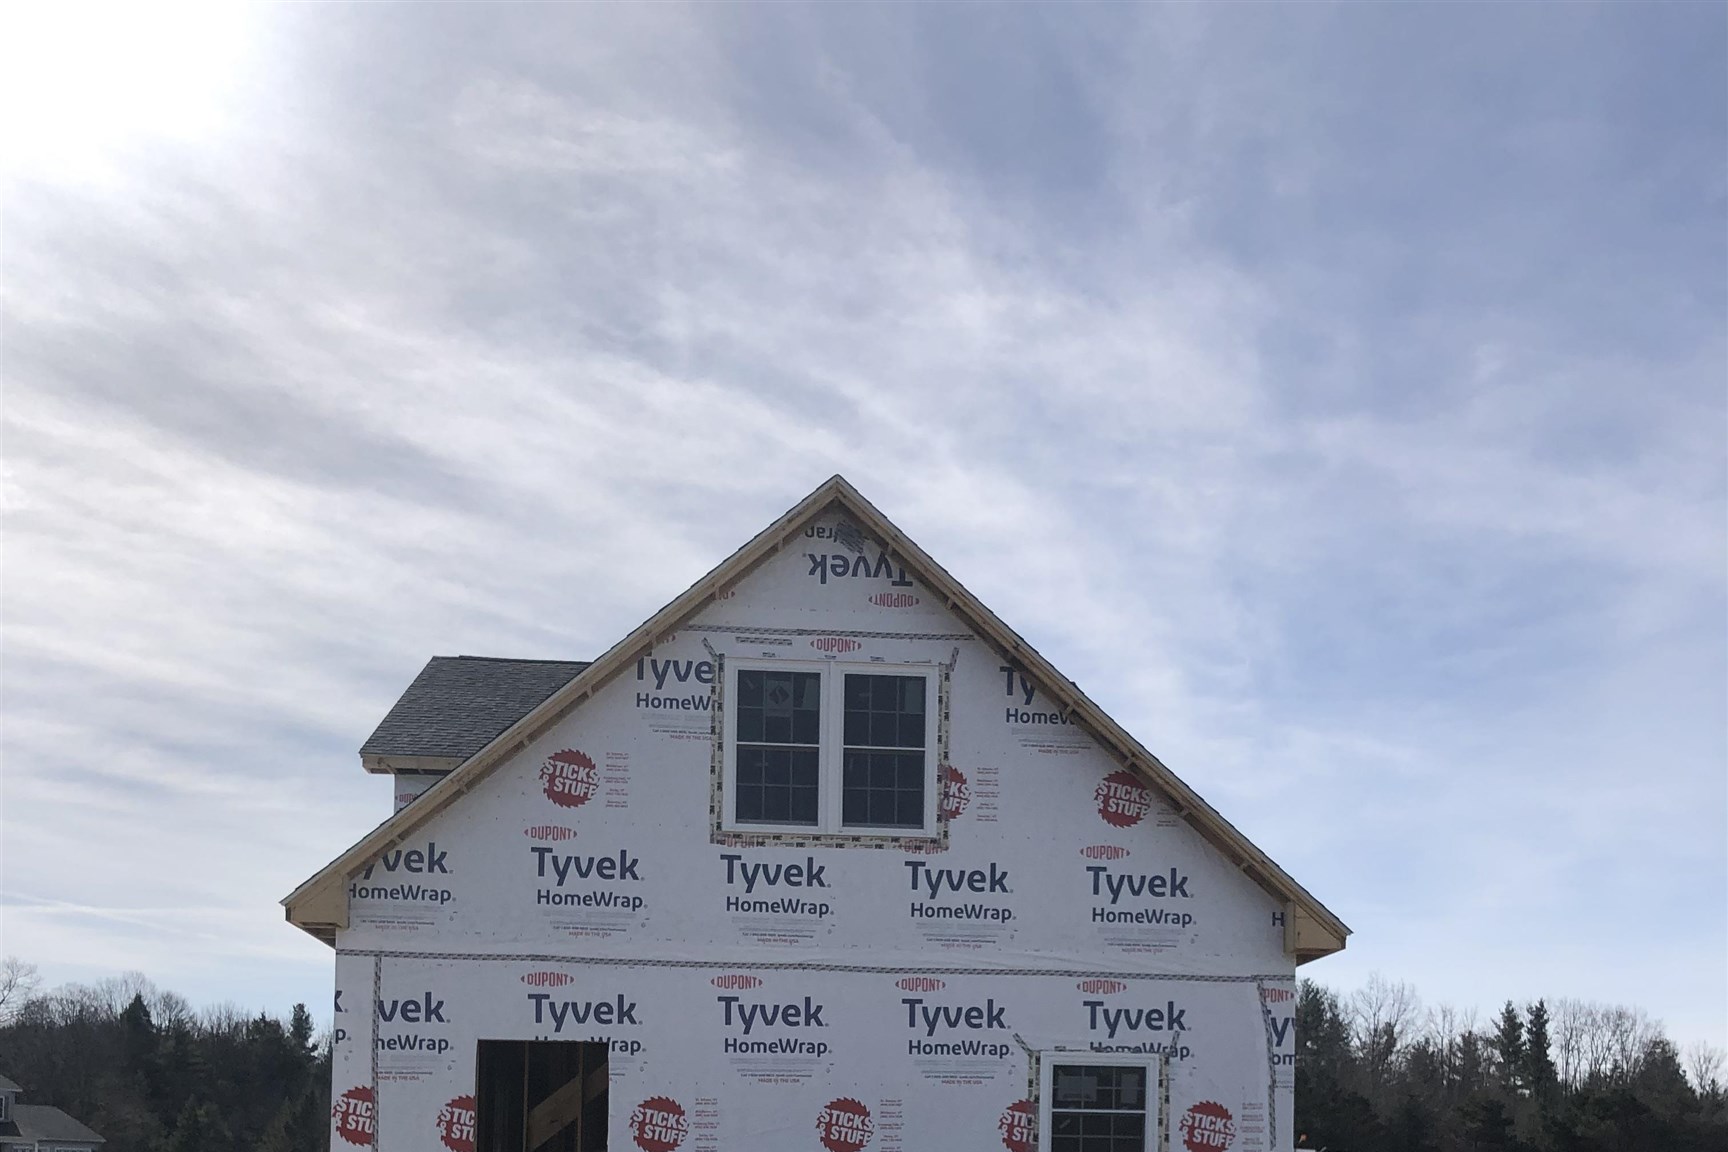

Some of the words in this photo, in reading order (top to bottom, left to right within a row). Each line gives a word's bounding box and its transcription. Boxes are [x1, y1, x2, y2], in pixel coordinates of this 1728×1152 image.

[816, 638, 858, 653] DUPONT
[636, 657, 714, 690] Tyve
[636, 692, 712, 711] HomeW
[545, 760, 600, 783] STICKS
[531, 826, 572, 841] DUPONT
[1086, 845, 1125, 860] DUPONT
[531, 847, 639, 886] Tyvek
[720, 854, 826, 893] Tyvek
[904, 861, 1009, 899] Tyvek
[1086, 866, 1190, 904] Tyvek
[527, 972, 569, 987] DUPONT
[716, 974, 757, 989] DUPONT
[901, 977, 941, 992] DUPONT
[1082, 981, 1122, 995] DUPONT
[1263, 988, 1290, 1003] PONT
[378, 991, 445, 1023] vek
[527, 994, 637, 1032] Tyvek
[717, 996, 824, 1034] Tyvek
[902, 998, 1006, 1036] Tyvek
[1083, 1001, 1187, 1038] Tyvek
[336, 1097, 373, 1116] STIC
[440, 1106, 475, 1125] STIC
[347, 1115, 373, 1134] STU
[634, 1107, 688, 1130] STICKS
[819, 1108, 875, 1131] STICKS
[1182, 1112, 1236, 1134] STICKS
